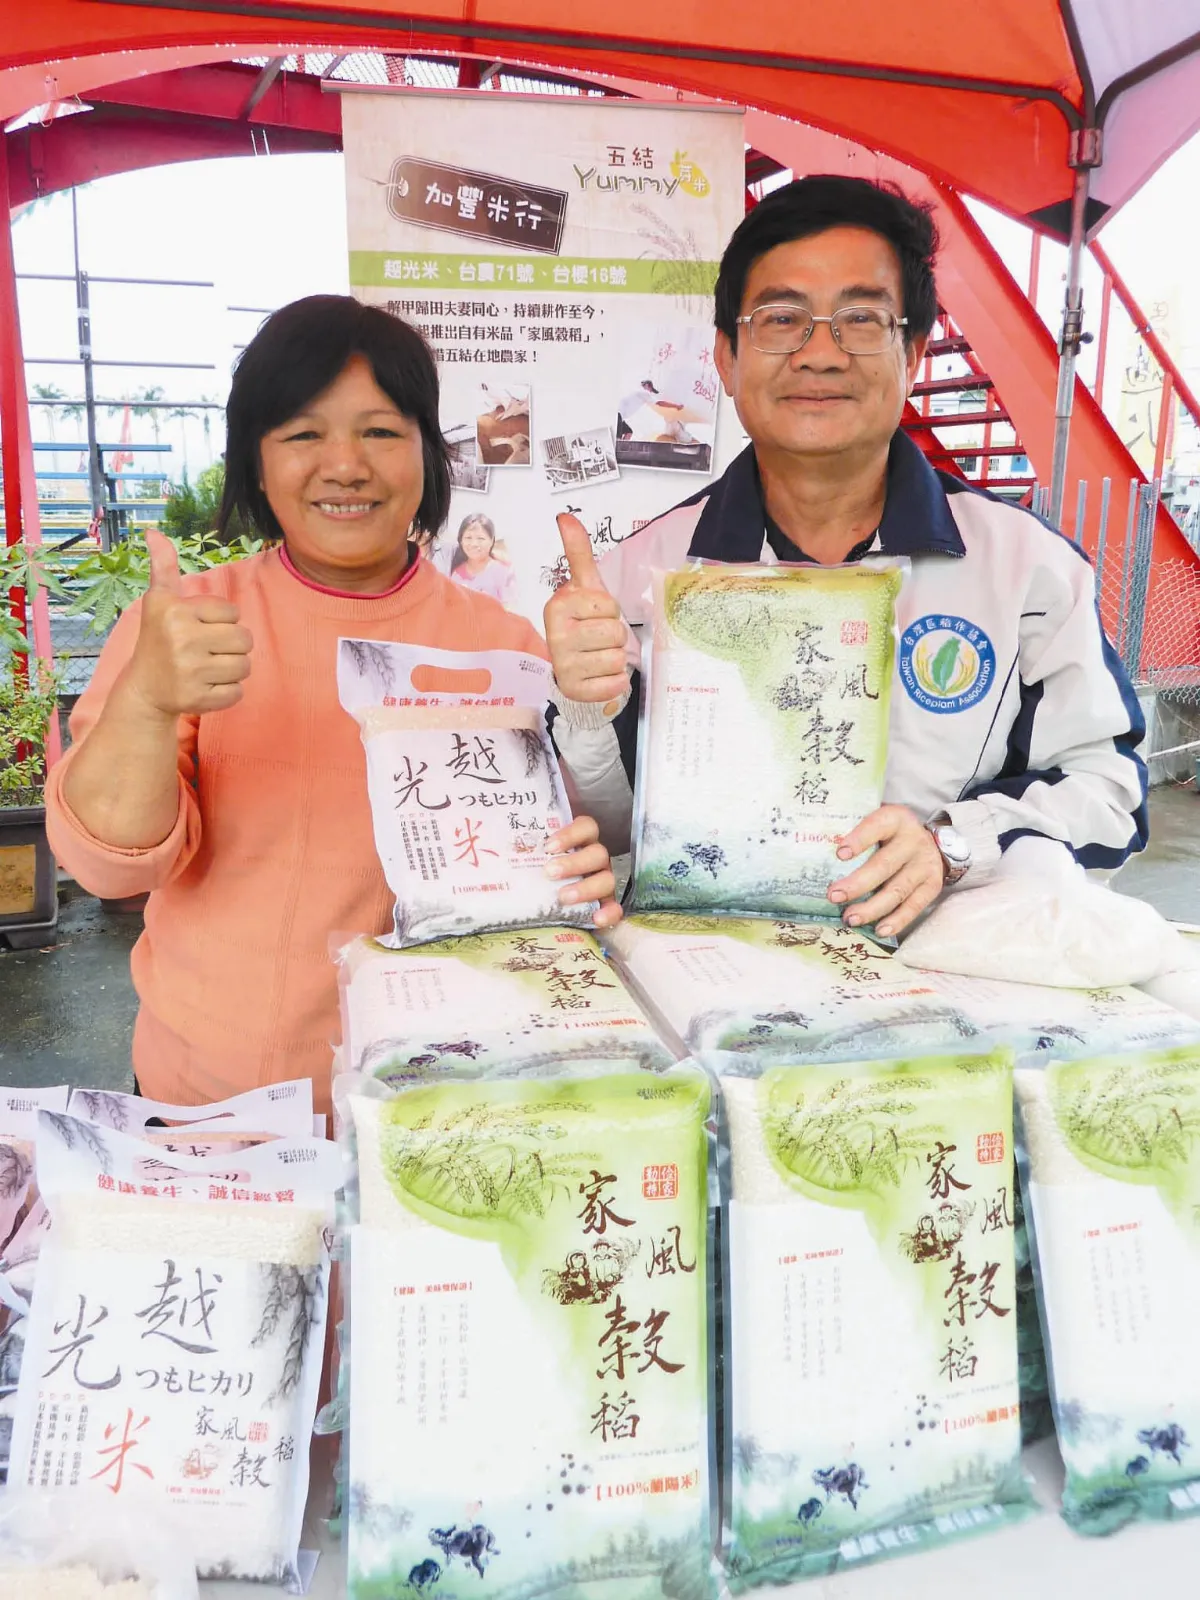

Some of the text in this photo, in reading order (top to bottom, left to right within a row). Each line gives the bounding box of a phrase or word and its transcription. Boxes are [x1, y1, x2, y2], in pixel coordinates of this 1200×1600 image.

[606, 145, 654, 169] 五結
[572, 163, 680, 196] Yummy
[424, 182, 543, 230] 加豐米行
[458, 791, 537, 807] つもヒカリ
[135, 1365, 254, 1397] つもヒカリ
